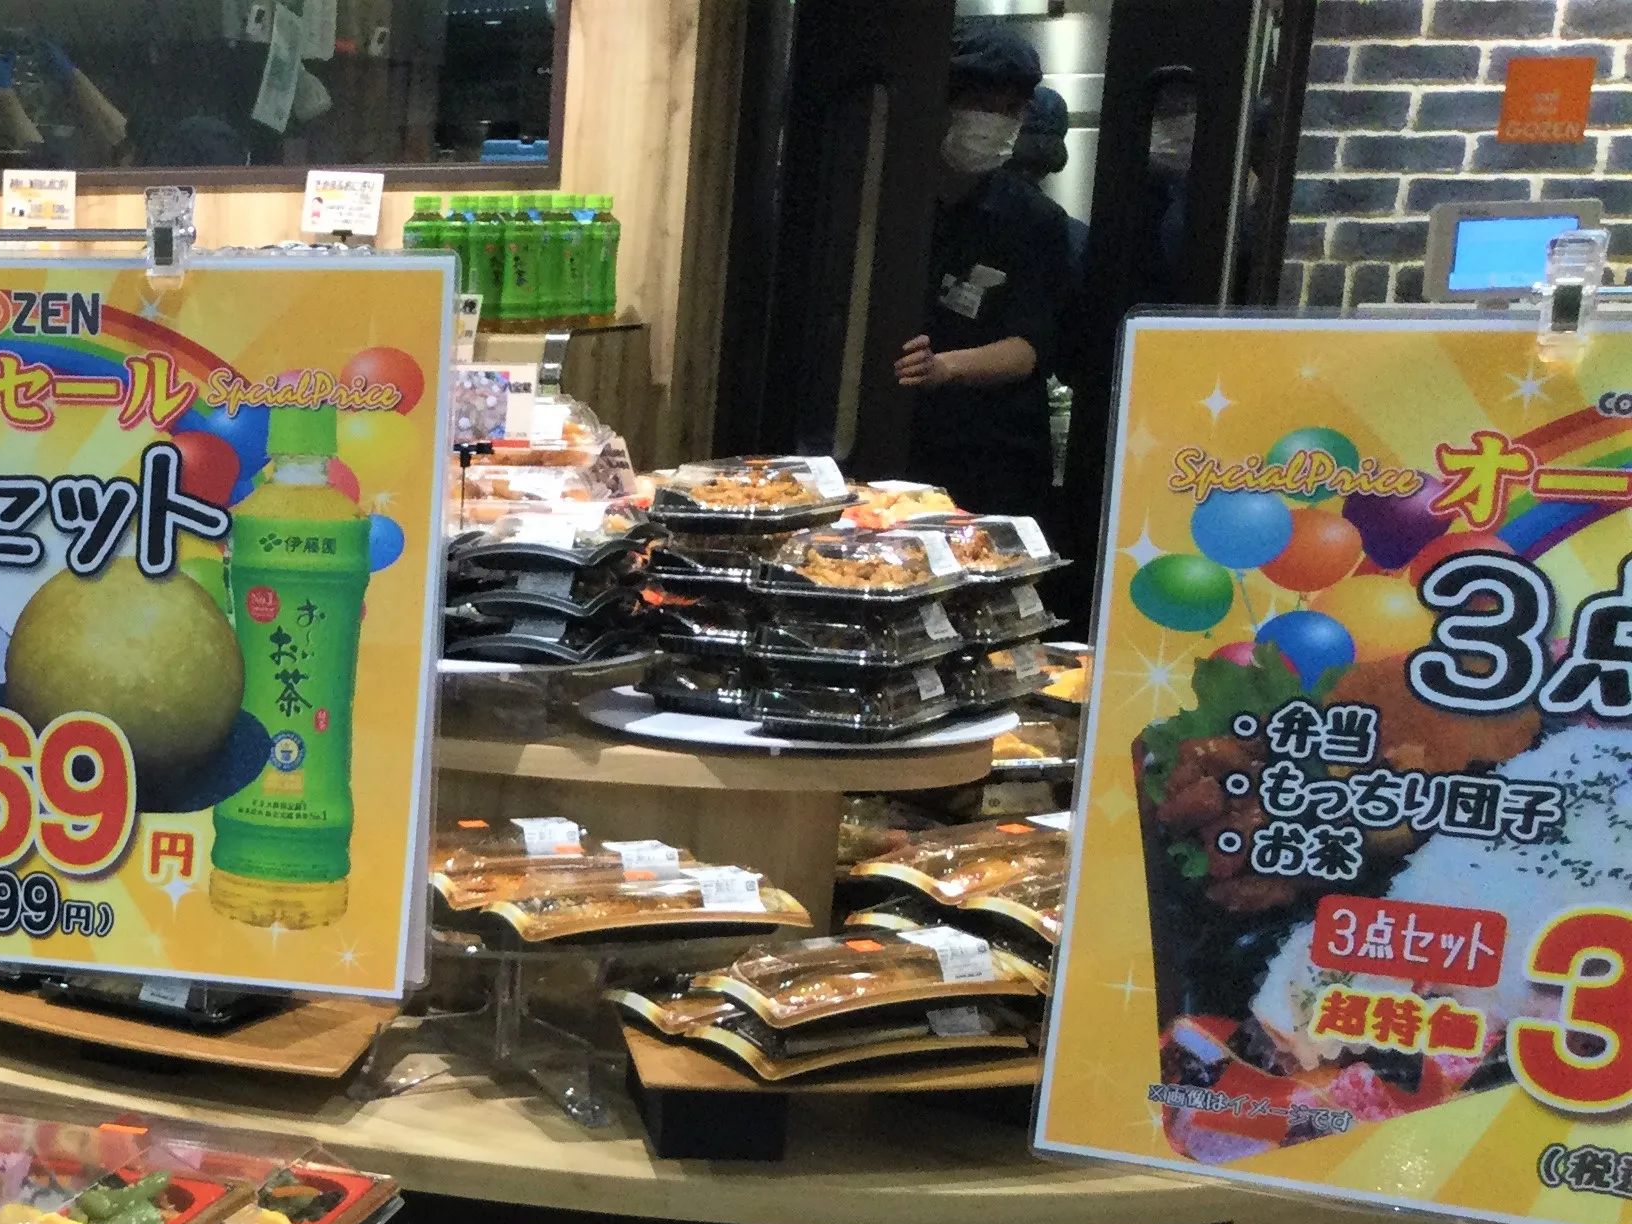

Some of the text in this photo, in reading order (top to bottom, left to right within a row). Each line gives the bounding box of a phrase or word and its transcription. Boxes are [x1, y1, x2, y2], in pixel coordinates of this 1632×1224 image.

[283, 534, 338, 556] 伊藤園
[269, 625, 314, 718] お茶
[1267, 700, 1380, 765] 弁当
[1259, 760, 1567, 843] もっちり団子
[144, 827, 200, 883] 円
[1250, 820, 1364, 882] お茶
[1328, 907, 1497, 972] 3点セット
[1313, 983, 1487, 1054] 超特価
